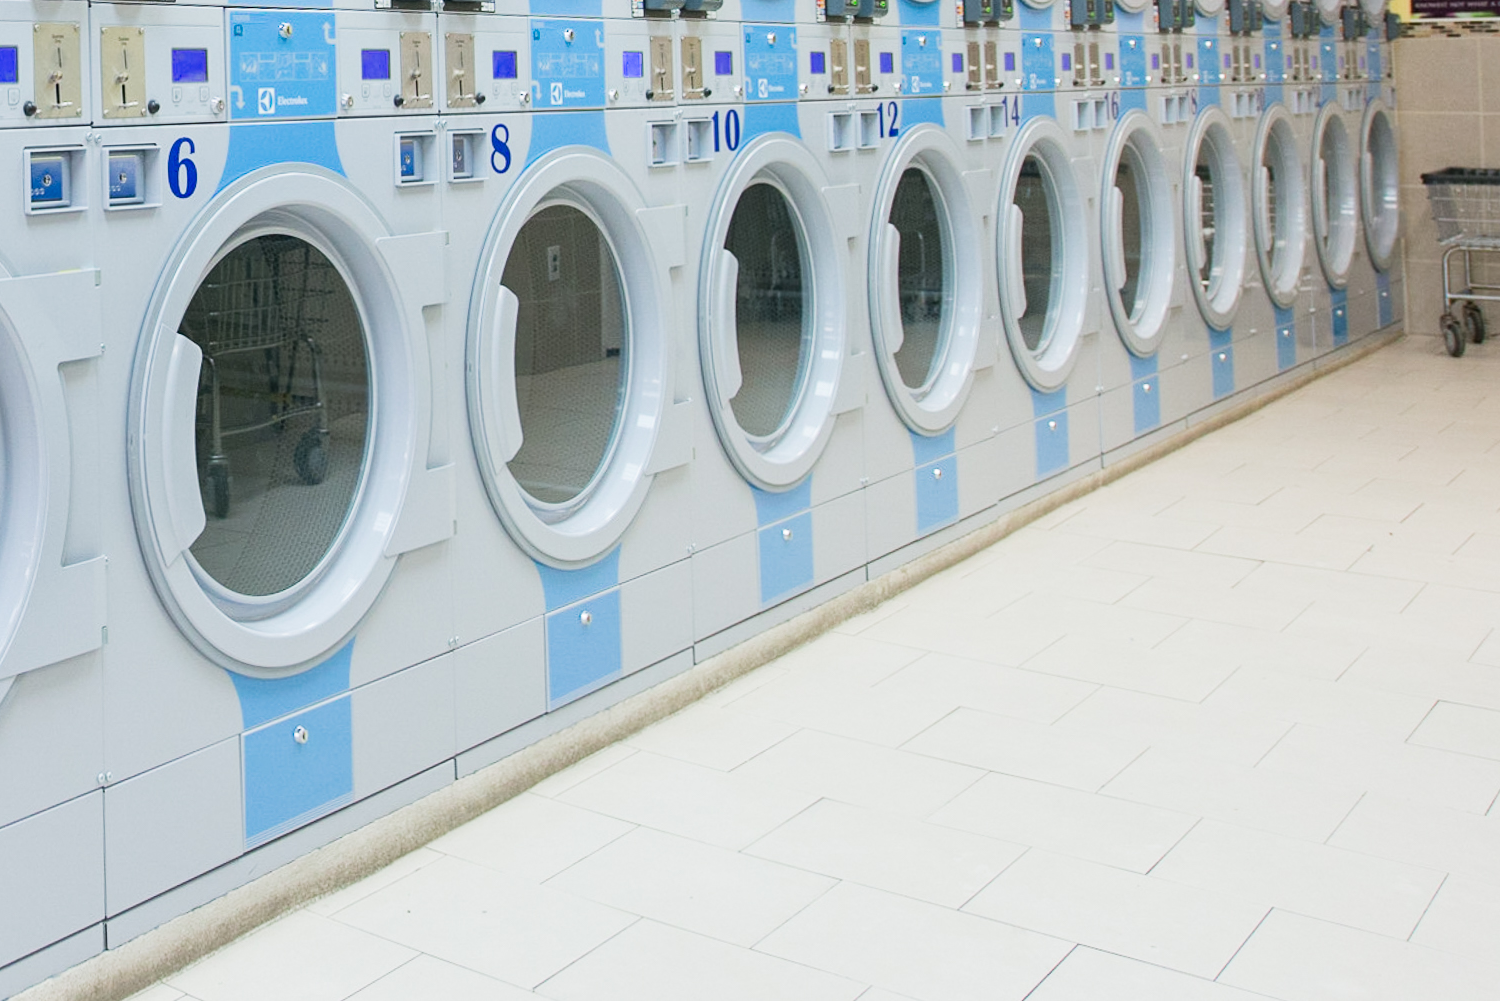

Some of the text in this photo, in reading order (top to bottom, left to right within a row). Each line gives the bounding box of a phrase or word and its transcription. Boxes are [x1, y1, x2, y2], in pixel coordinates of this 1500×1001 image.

[277, 96, 308, 106] Electrolux
[876, 101, 899, 139] 12
[1002, 95, 1019, 128] 14
[1104, 91, 1119, 121] 16
[490, 123, 512, 175] 8
[711, 109, 741, 153] 10
[167, 136, 198, 199] 6
